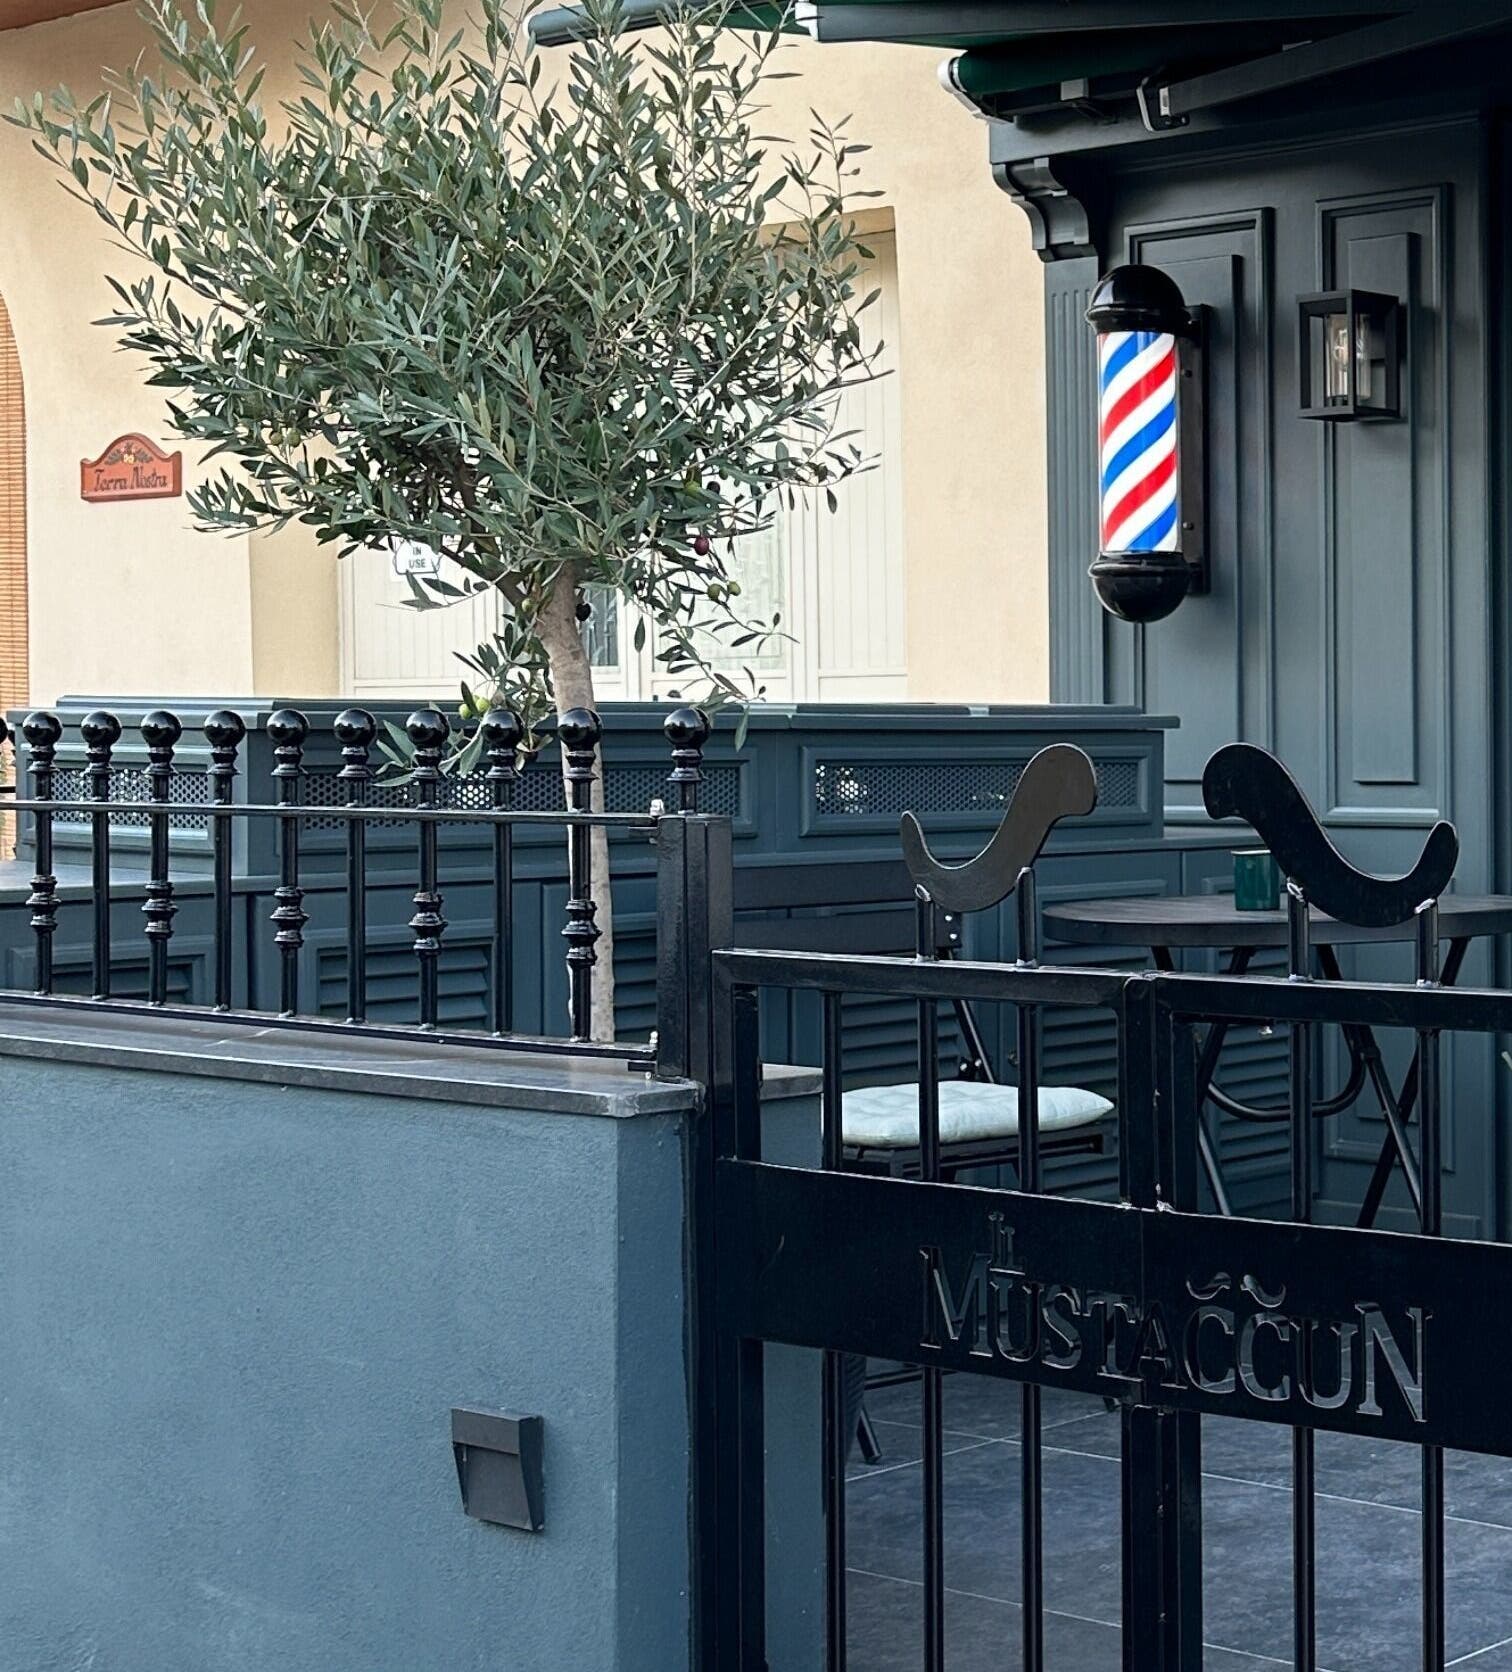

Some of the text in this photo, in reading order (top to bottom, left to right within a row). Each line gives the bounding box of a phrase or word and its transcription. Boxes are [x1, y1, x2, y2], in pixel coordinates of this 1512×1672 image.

[94, 466, 167, 491] Terra Nostra
[412, 547, 421, 555] IN
[409, 559, 426, 569] USE
